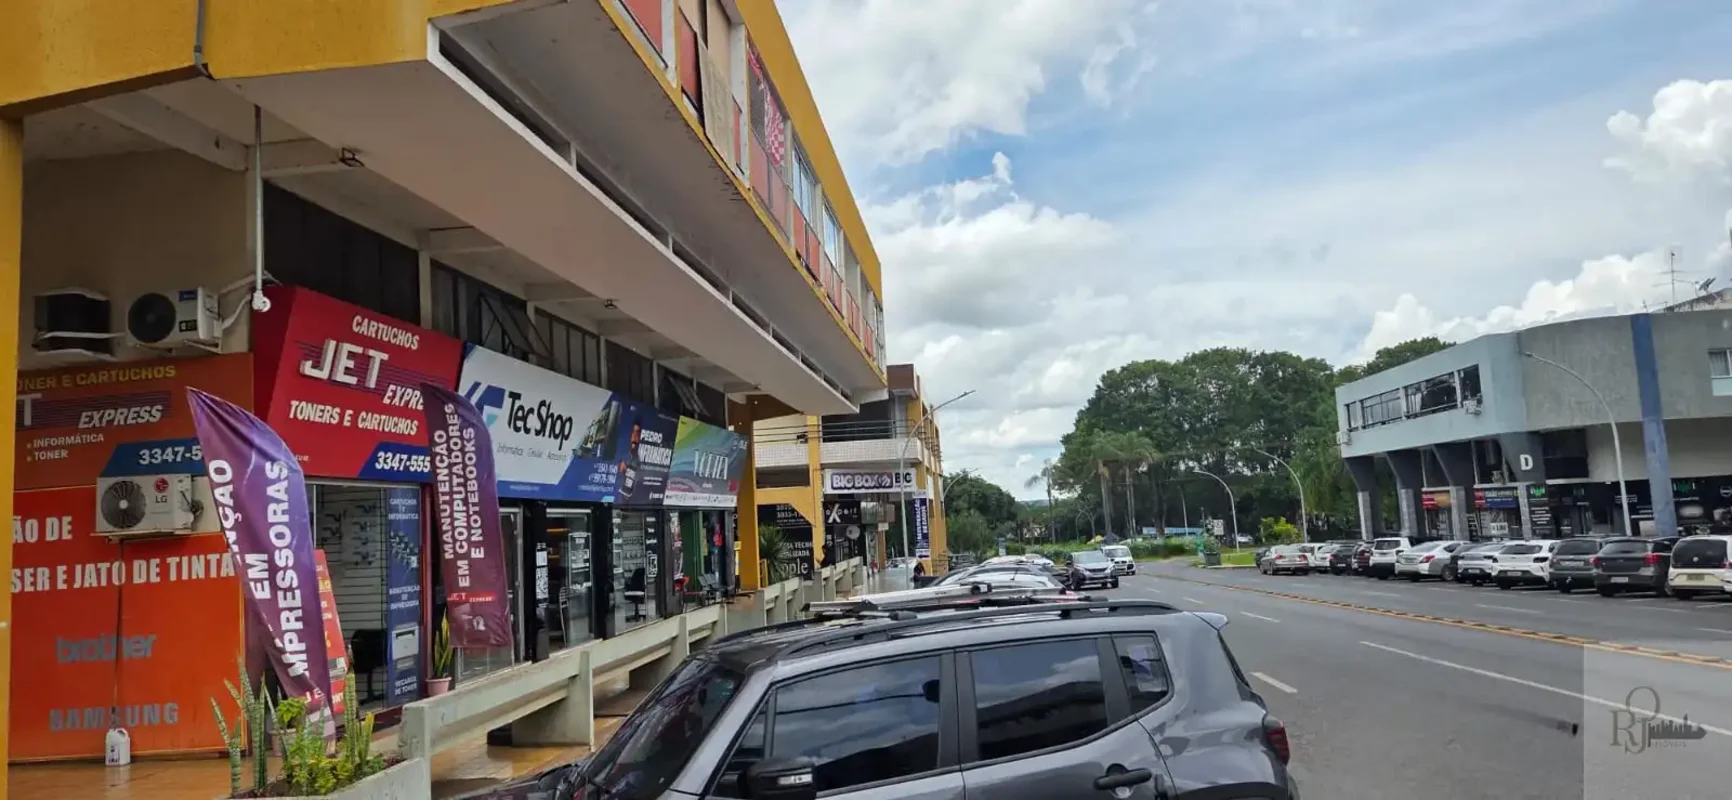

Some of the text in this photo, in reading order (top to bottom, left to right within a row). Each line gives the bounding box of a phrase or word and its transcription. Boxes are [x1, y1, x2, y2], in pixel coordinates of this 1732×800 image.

[352, 315, 420, 350] CARTUCHOS
[62, 374, 72, 387] E
[76, 365, 176, 386] CARTUCHOS
[300, 339, 389, 389] JET
[78, 405, 163, 429] EXPRESS
[289, 400, 419, 435] TONERS E CARTUCHOS
[33, 433, 104, 448] INFORMÁTICA
[640, 429, 662, 443] PEDRO
[34, 449, 68, 461] TONER
[1520, 454, 1533, 470] D
[432, 429, 454, 560] MANUTENÇÃO
[463, 427, 484, 559] E NOTEBOOKS
[832, 474, 879, 488] BIG BOX
[156, 495, 167, 504] LG
[445, 403, 471, 588] EM COMPUTADORES
[46, 515, 73, 542] DE
[11, 551, 236, 593] SER E JATO DE TINTA
[245, 553, 271, 600] EM
[56, 635, 157, 664] brother
